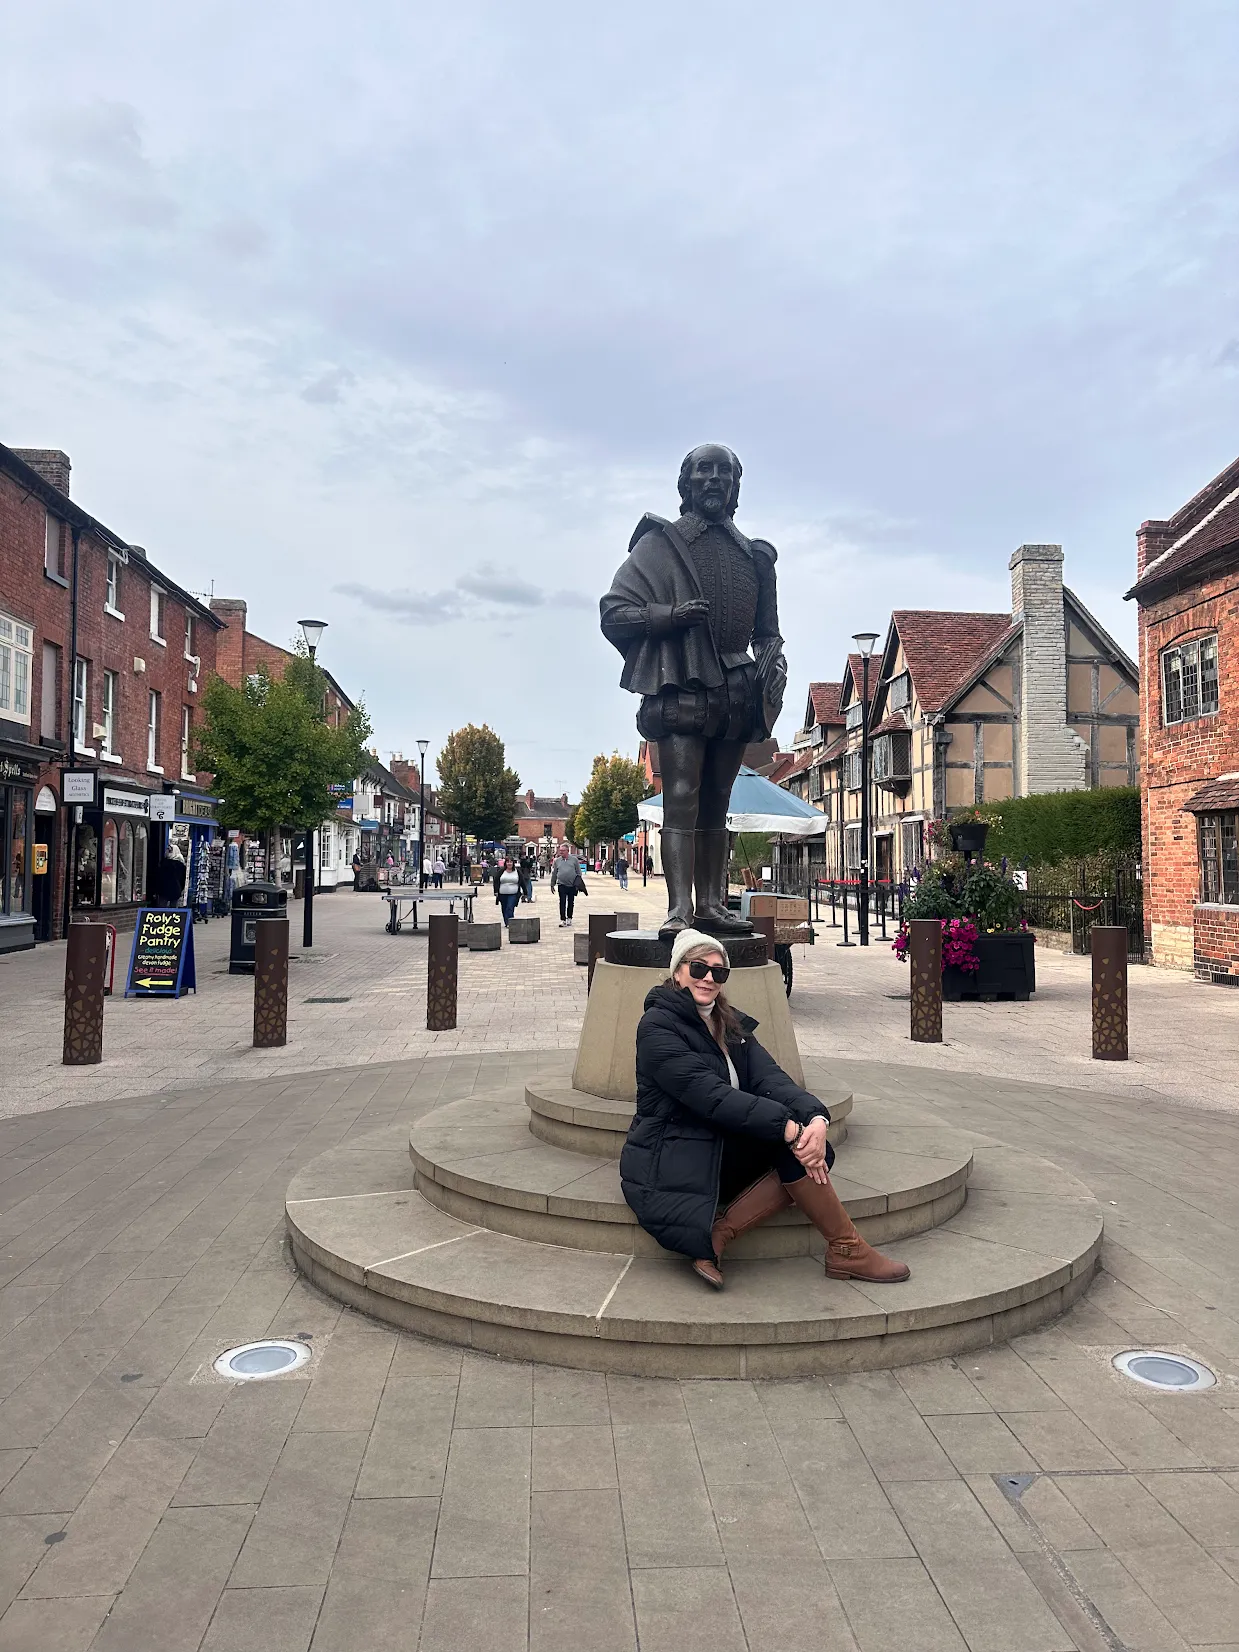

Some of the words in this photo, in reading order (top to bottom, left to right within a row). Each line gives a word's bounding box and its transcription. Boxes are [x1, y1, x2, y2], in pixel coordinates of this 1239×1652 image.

[145, 913, 181, 925] Roly's
[142, 924, 181, 937] Fudge
[139, 936, 181, 948] Pantry
[134, 966, 148, 974] See
